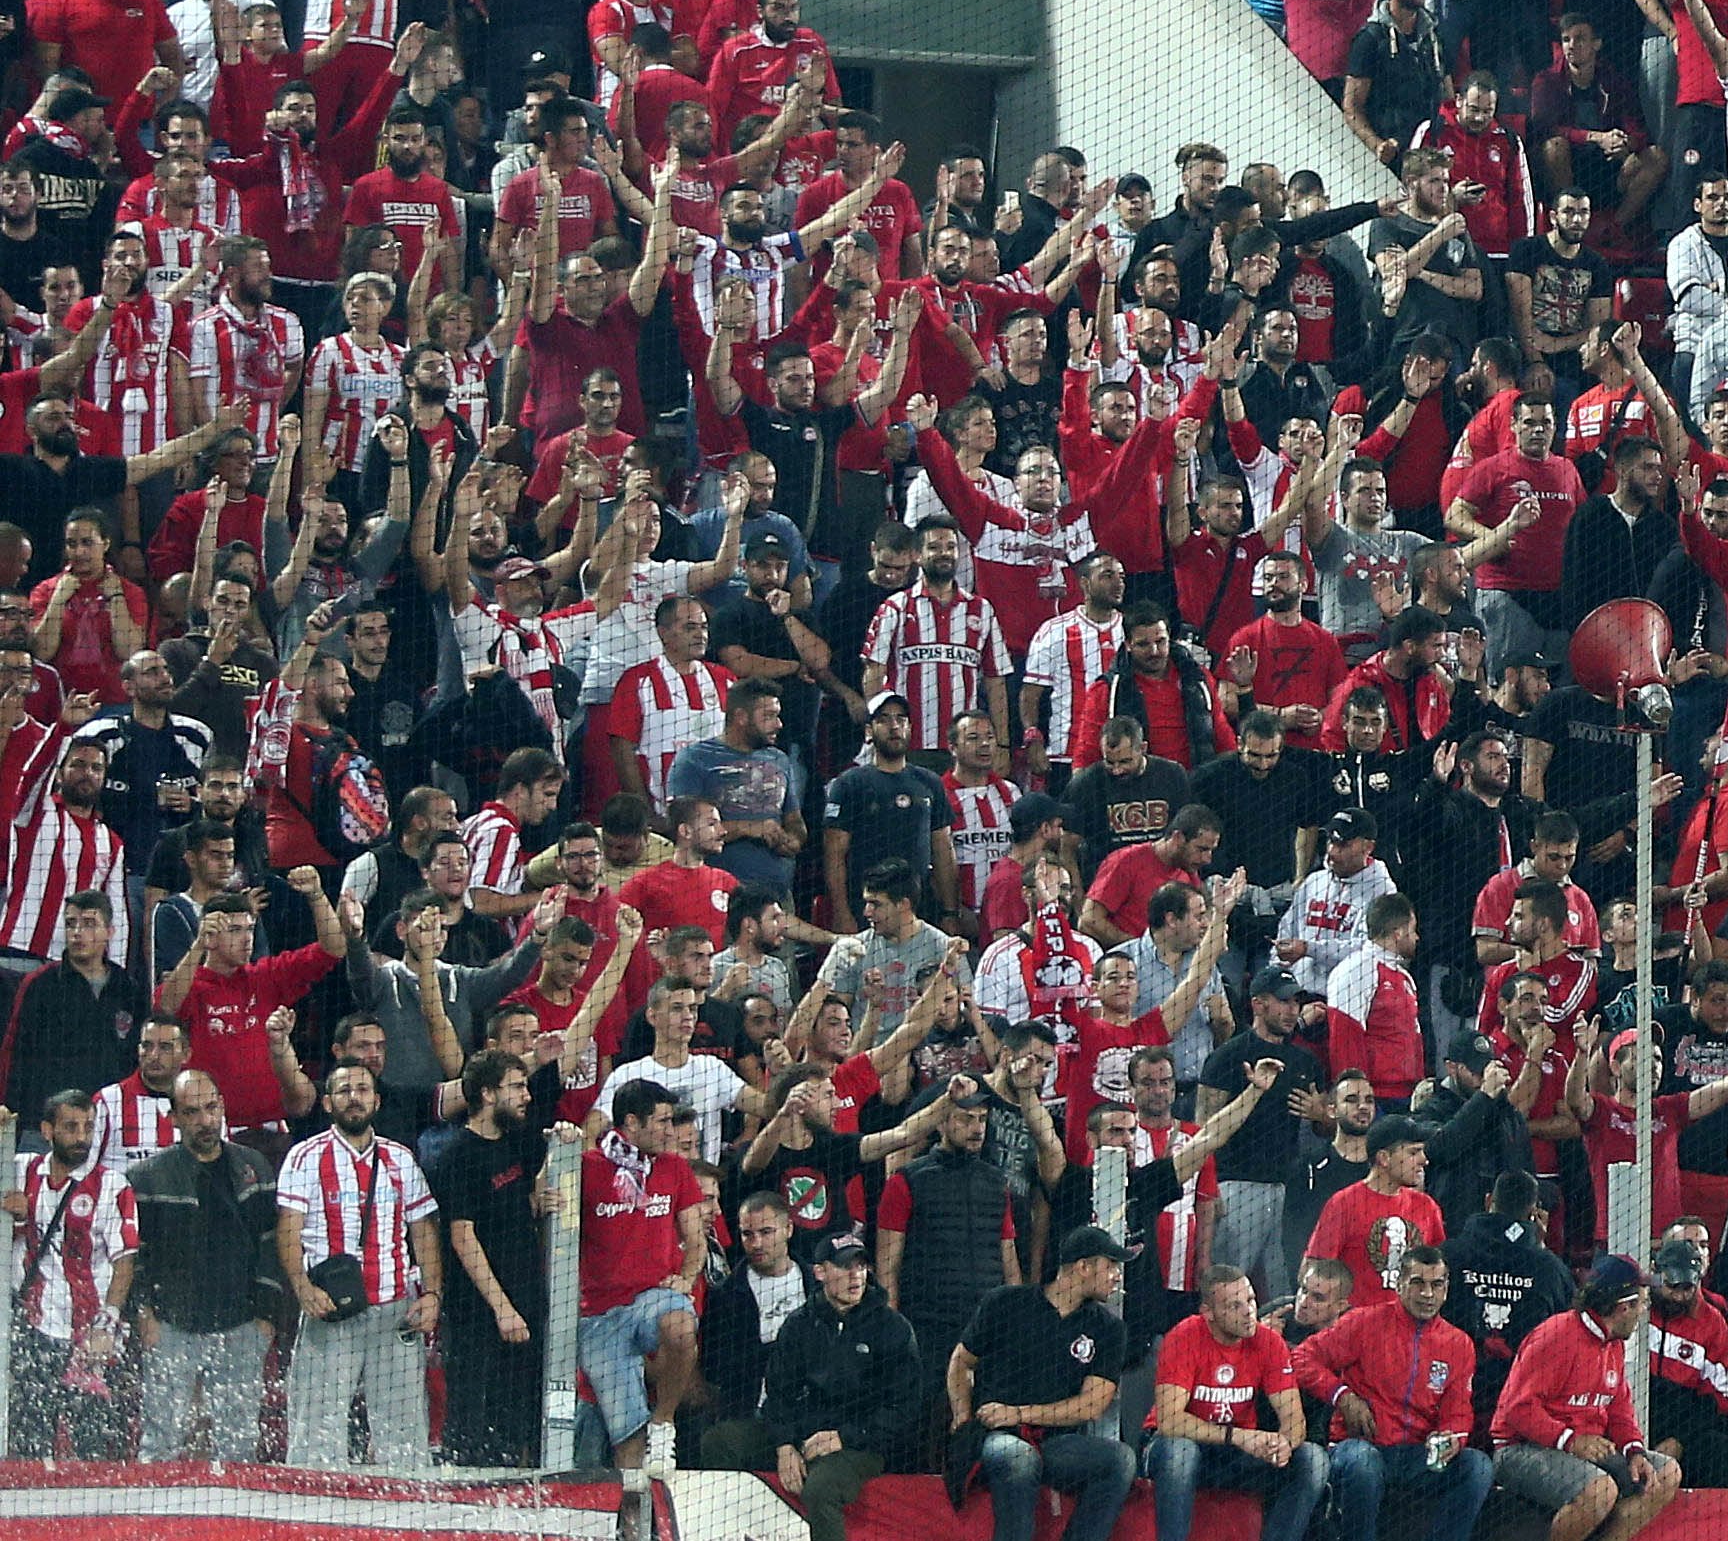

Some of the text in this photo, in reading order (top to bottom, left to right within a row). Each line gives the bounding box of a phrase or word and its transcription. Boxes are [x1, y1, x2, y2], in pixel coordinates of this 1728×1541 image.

[901, 647, 941, 662] ASPIS
[1463, 1270, 1534, 1289] Kritikos
[1474, 1285, 1523, 1303] Camp
